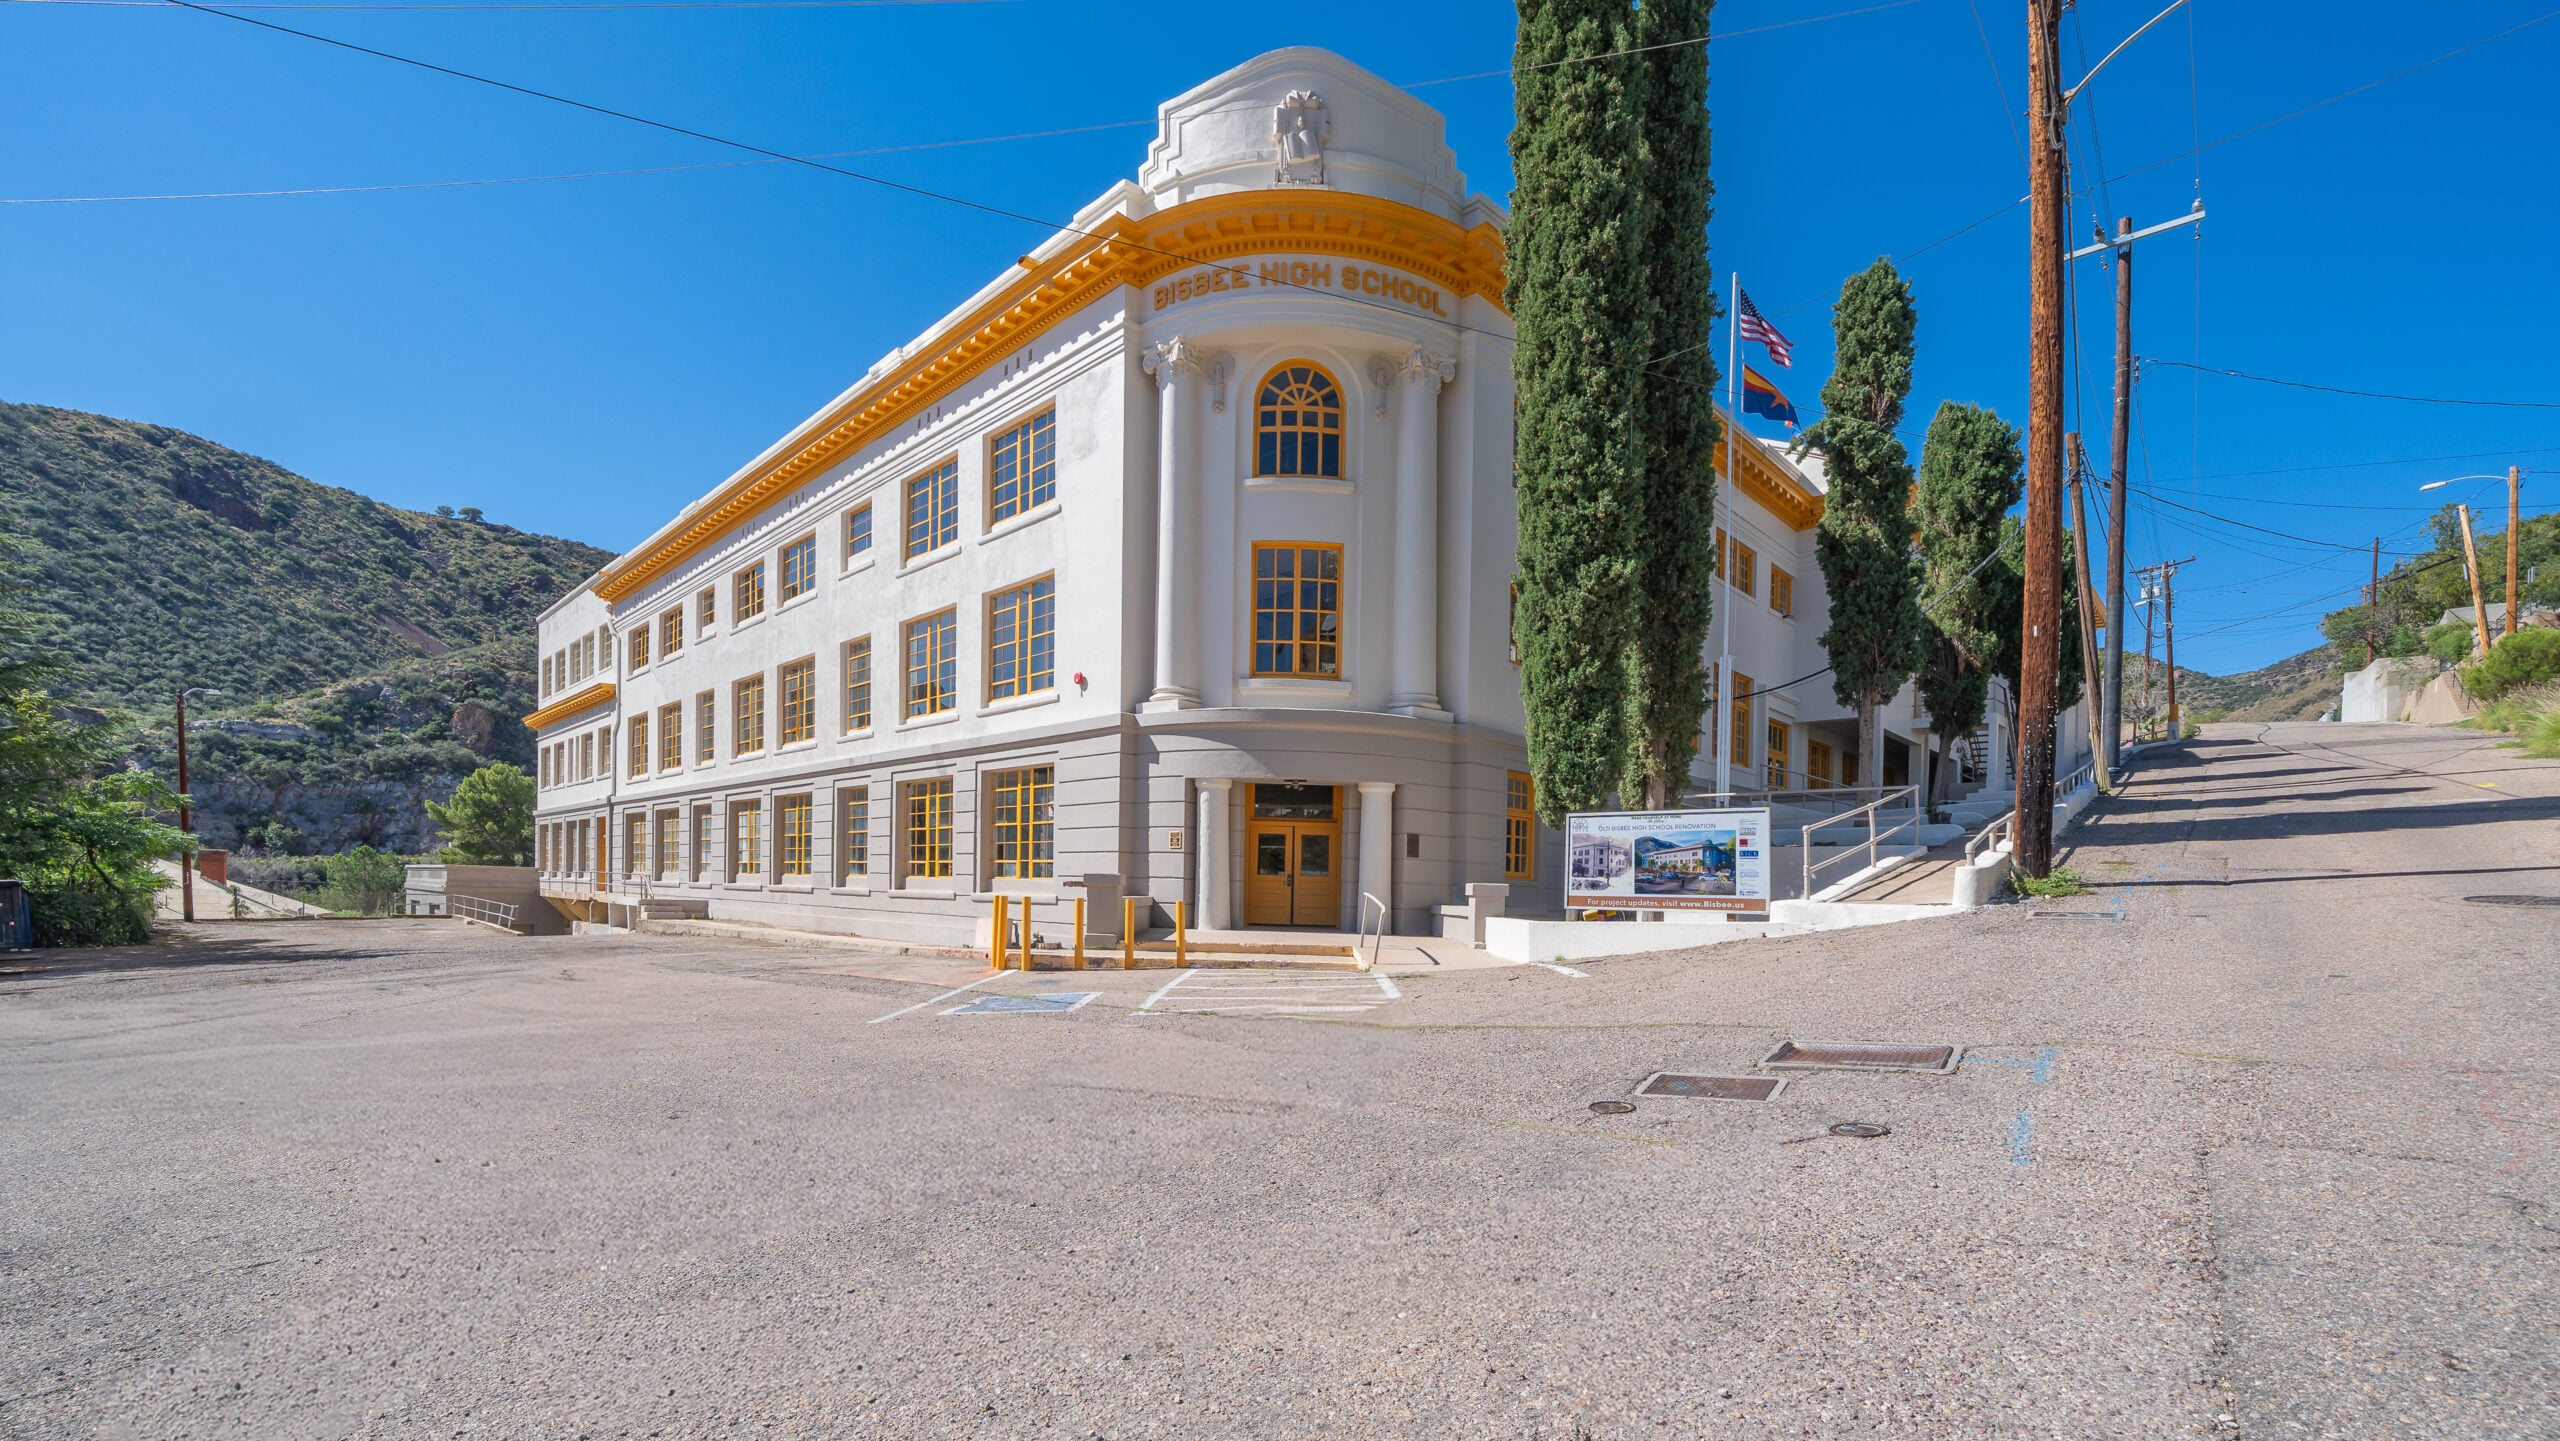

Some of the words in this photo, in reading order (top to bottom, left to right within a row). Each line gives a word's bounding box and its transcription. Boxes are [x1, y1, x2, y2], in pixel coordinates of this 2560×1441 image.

[1153, 264, 1250, 312] BISBEE
[1260, 261, 1331, 287] HIGH
[1341, 266, 1447, 318] SCHOOL
[1600, 899, 1626, 907] project
[1679, 901, 1745, 909] www.Bisbee.us
